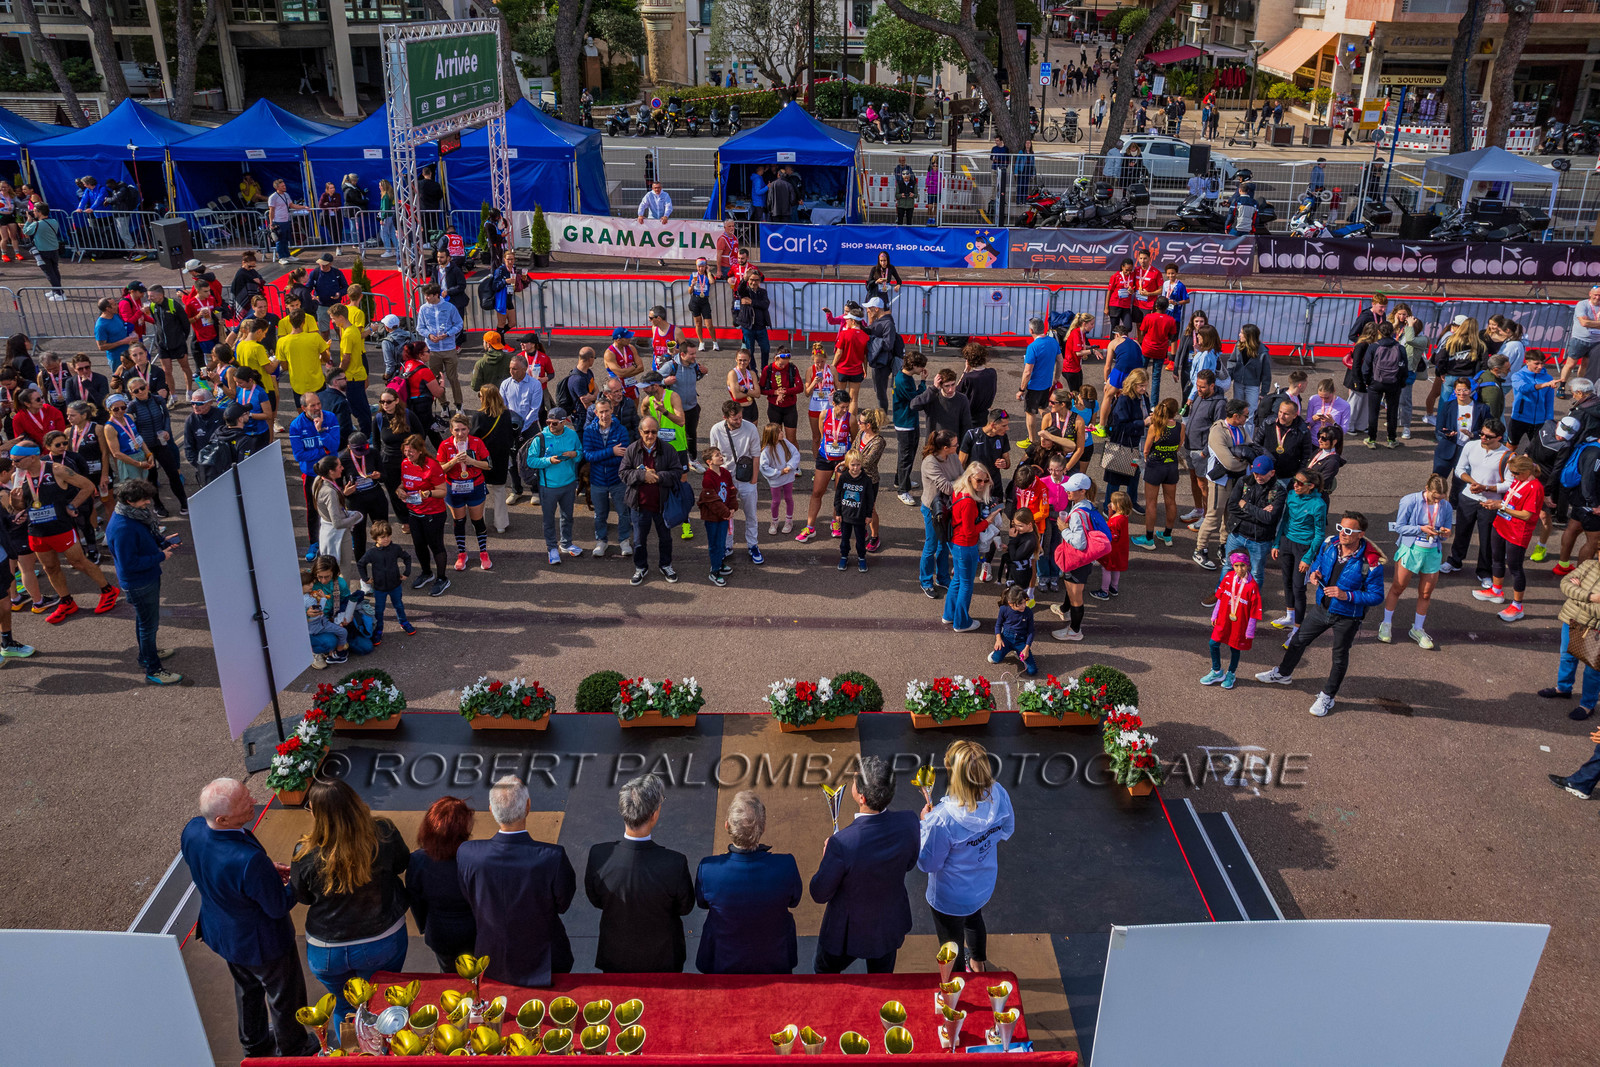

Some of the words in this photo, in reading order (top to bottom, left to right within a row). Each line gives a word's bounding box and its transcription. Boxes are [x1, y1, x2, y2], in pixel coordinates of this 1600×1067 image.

[435, 47, 478, 80] Arrivée
[1397, 76, 1442, 84] SOUVENIRS
[563, 225, 716, 250] GRAMAGLIA
[767, 233, 828, 253] Carlo
[865, 243, 894, 251] SMART,
[896, 243, 918, 251] SHOP
[1027, 242, 1129, 255] RUNNING
[1166, 241, 1254, 255] CYCLE
[1030, 254, 1107, 264] GRASSE
[1161, 253, 1250, 266] PASSION
[1258, 240, 1340, 270] diadora
[1353, 243, 1437, 273] diadora
[1451, 245, 1538, 276] diadora
[842, 482, 864, 492] PRESS
[841, 498, 861, 508] START
